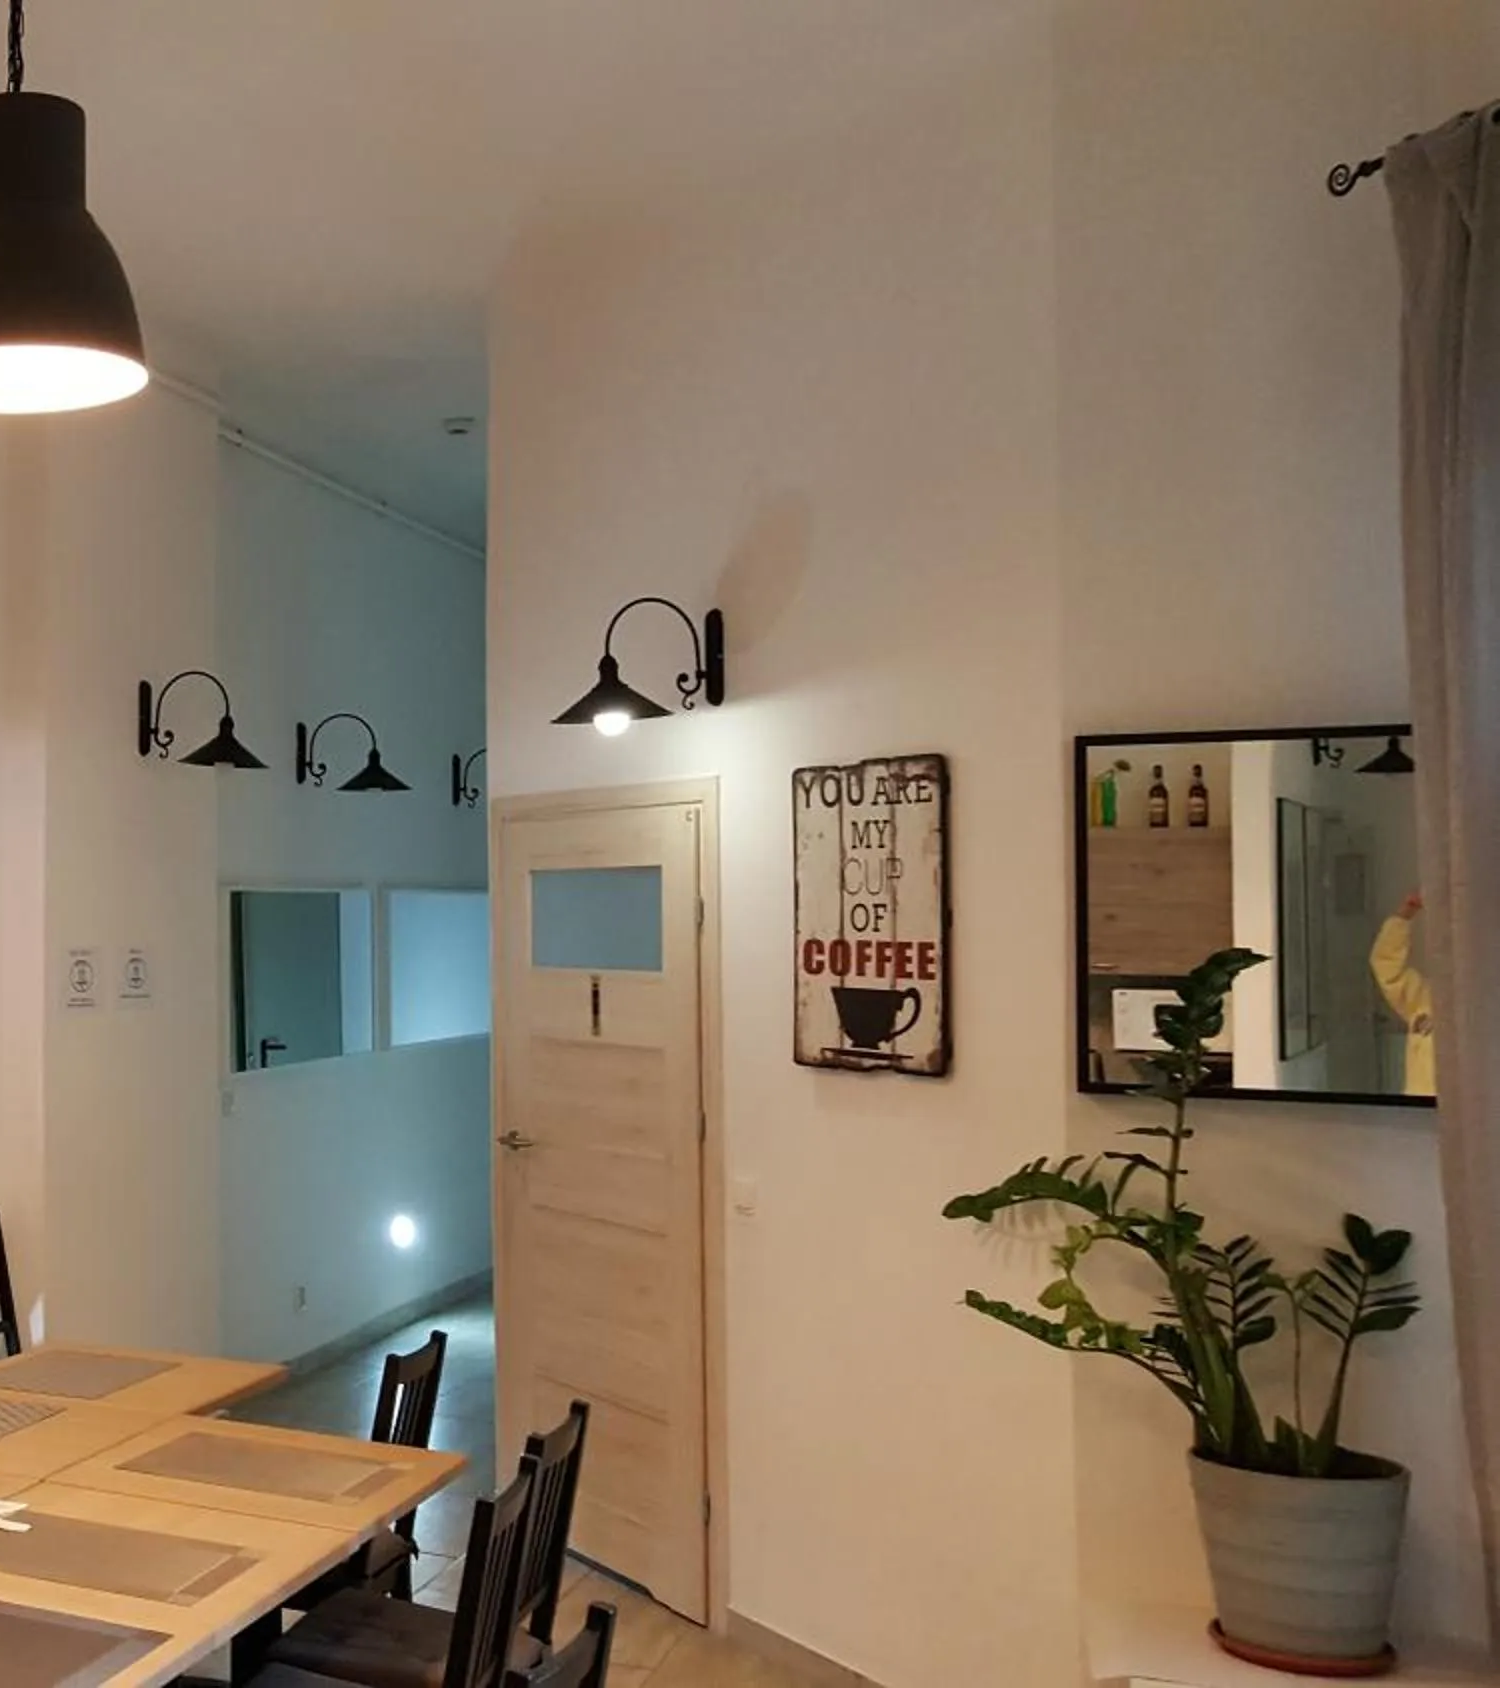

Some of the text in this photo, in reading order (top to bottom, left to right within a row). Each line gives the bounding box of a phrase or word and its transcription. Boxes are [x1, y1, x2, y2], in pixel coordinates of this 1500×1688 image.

[800, 773, 933, 808] YOU ARE
[851, 819, 890, 849] MY
[843, 857, 903, 896] CUP
[851, 903, 887, 932] OF
[803, 938, 936, 980] COFFEE
